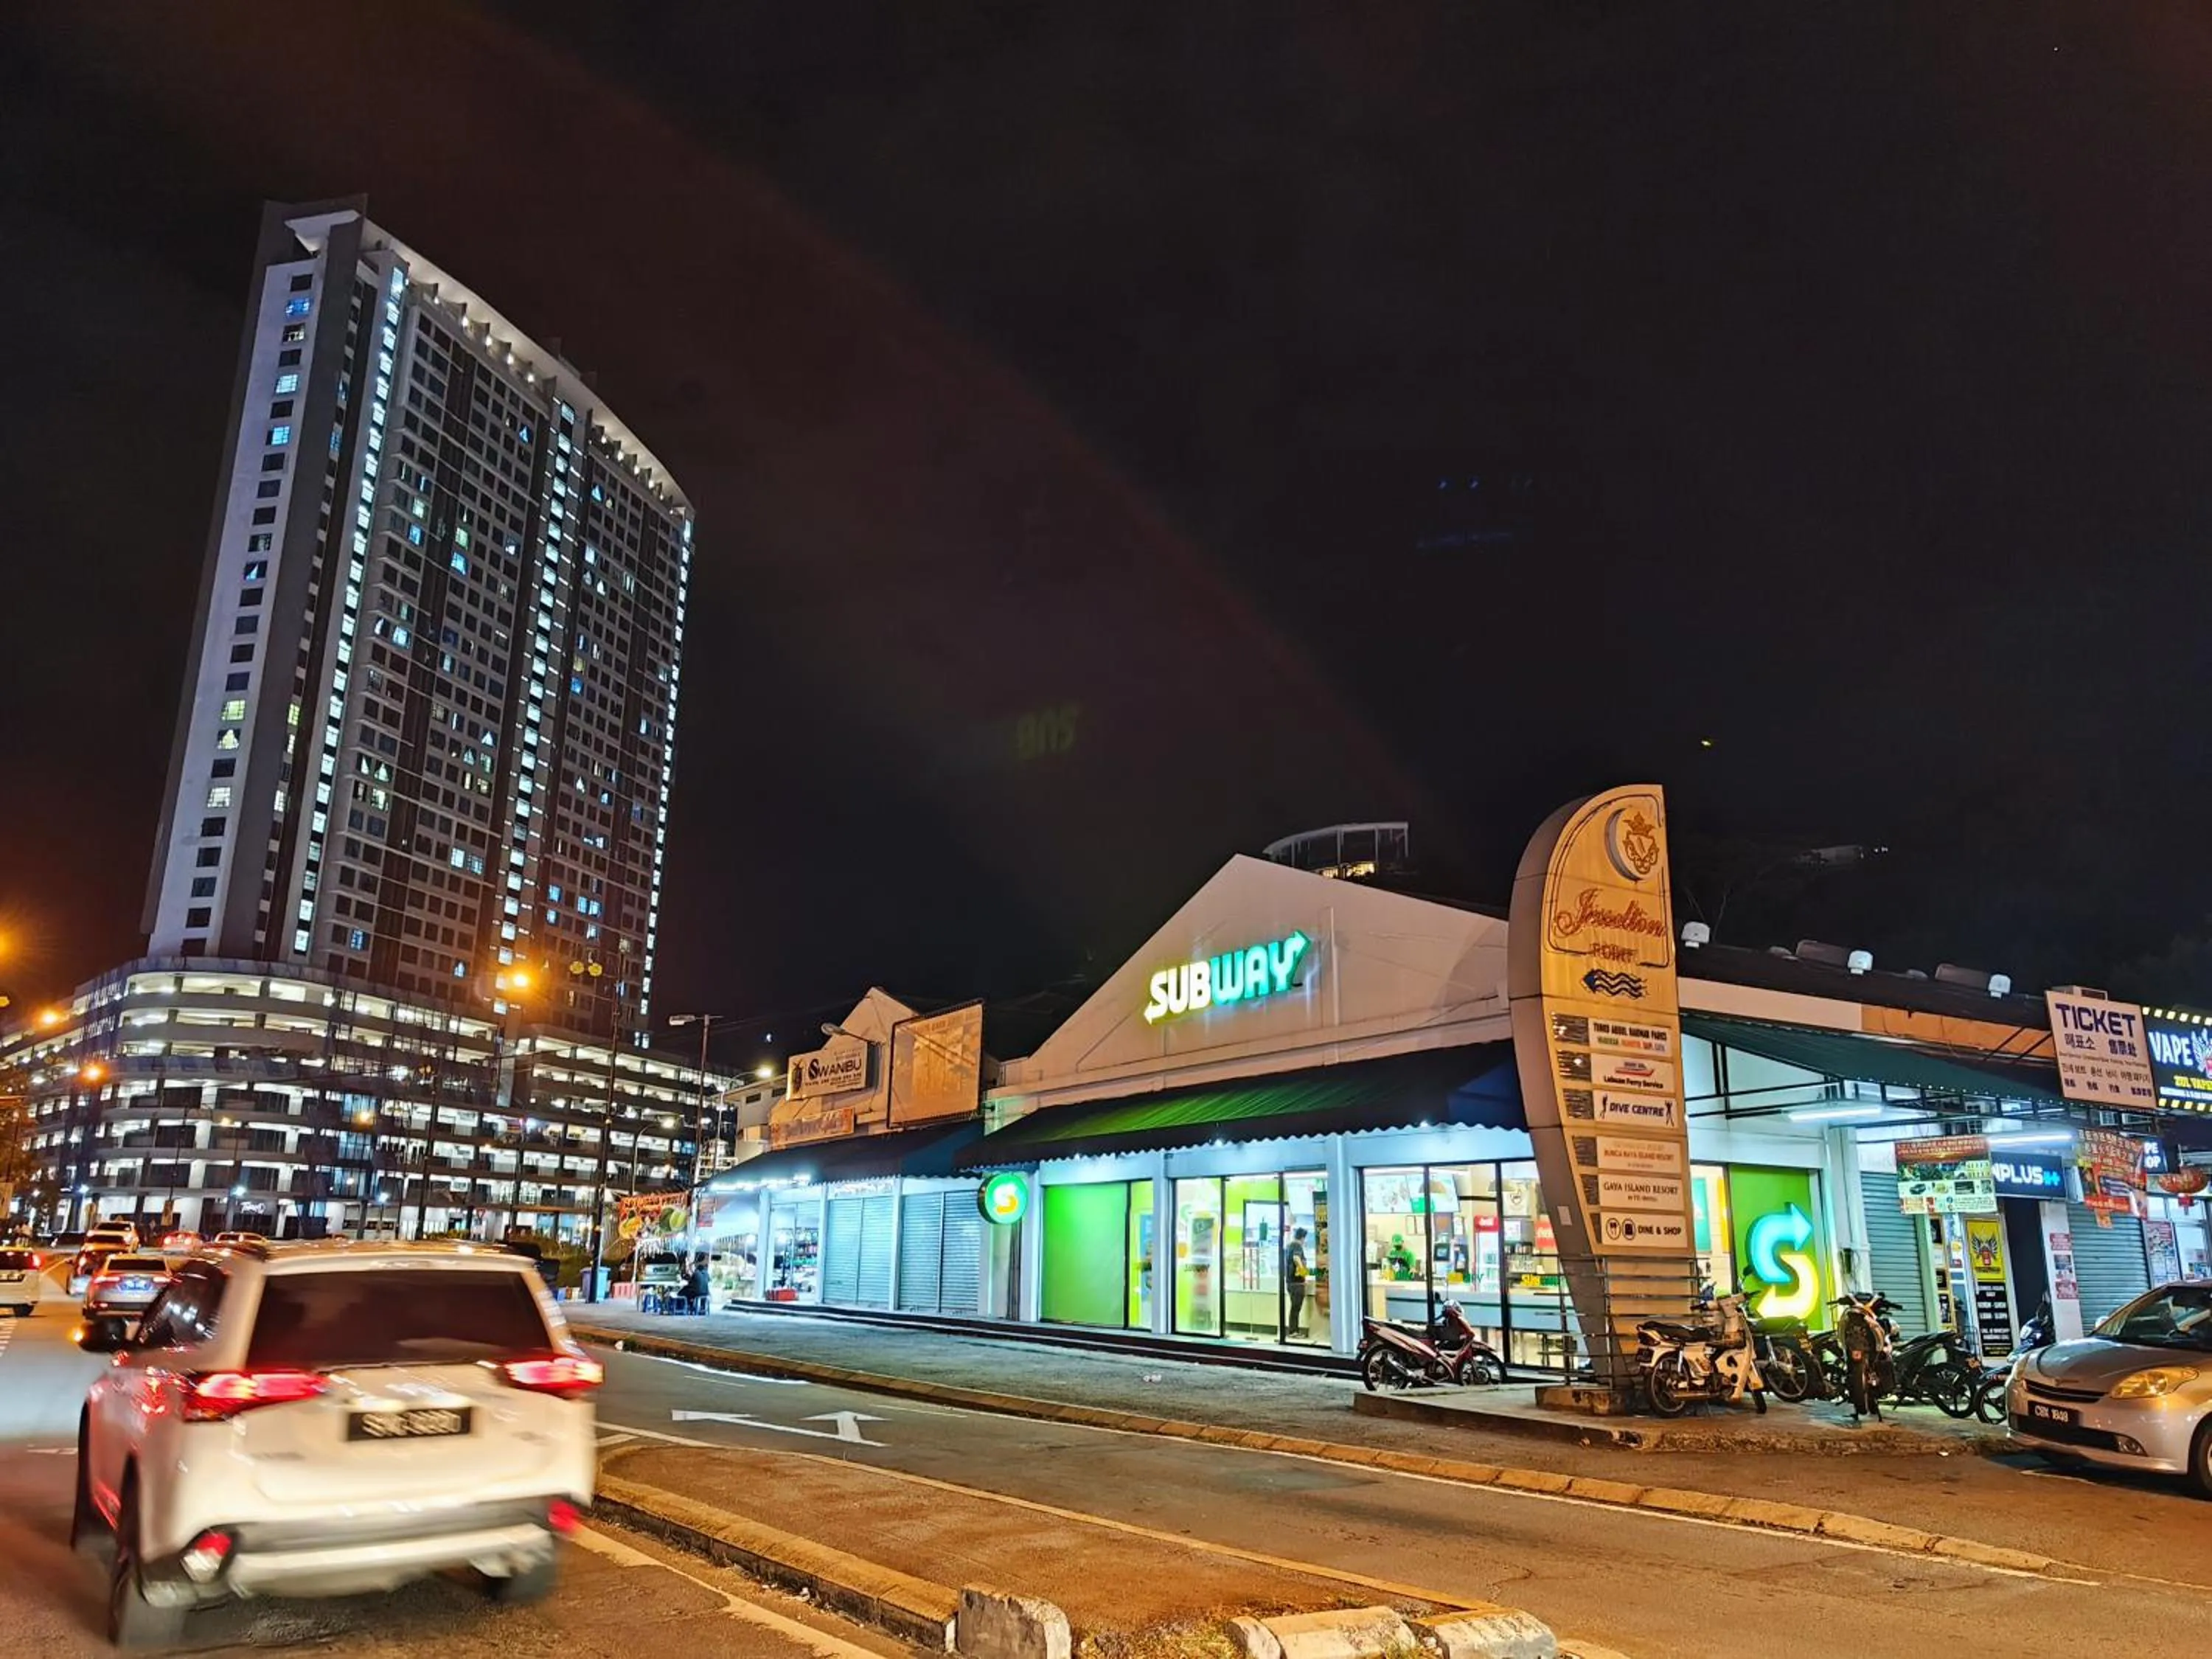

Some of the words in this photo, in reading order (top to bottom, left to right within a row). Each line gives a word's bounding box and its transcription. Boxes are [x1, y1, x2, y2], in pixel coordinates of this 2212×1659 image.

[1144, 929, 1312, 1025] SUBWAY
[2055, 1003, 2136, 1037] TICKET
[2148, 1031, 2194, 1066] VAPE
[1610, 1102, 1629, 1113] DIVE
[1632, 1104, 1665, 1117] CENTRE
[1604, 1181, 1622, 1192] GAYA
[1624, 1183, 1651, 1193] ISLAND
[1652, 1184, 1679, 1195] RESORT
[1638, 1225, 1653, 1234] DINE
[1663, 1226, 1682, 1235] SHOP
